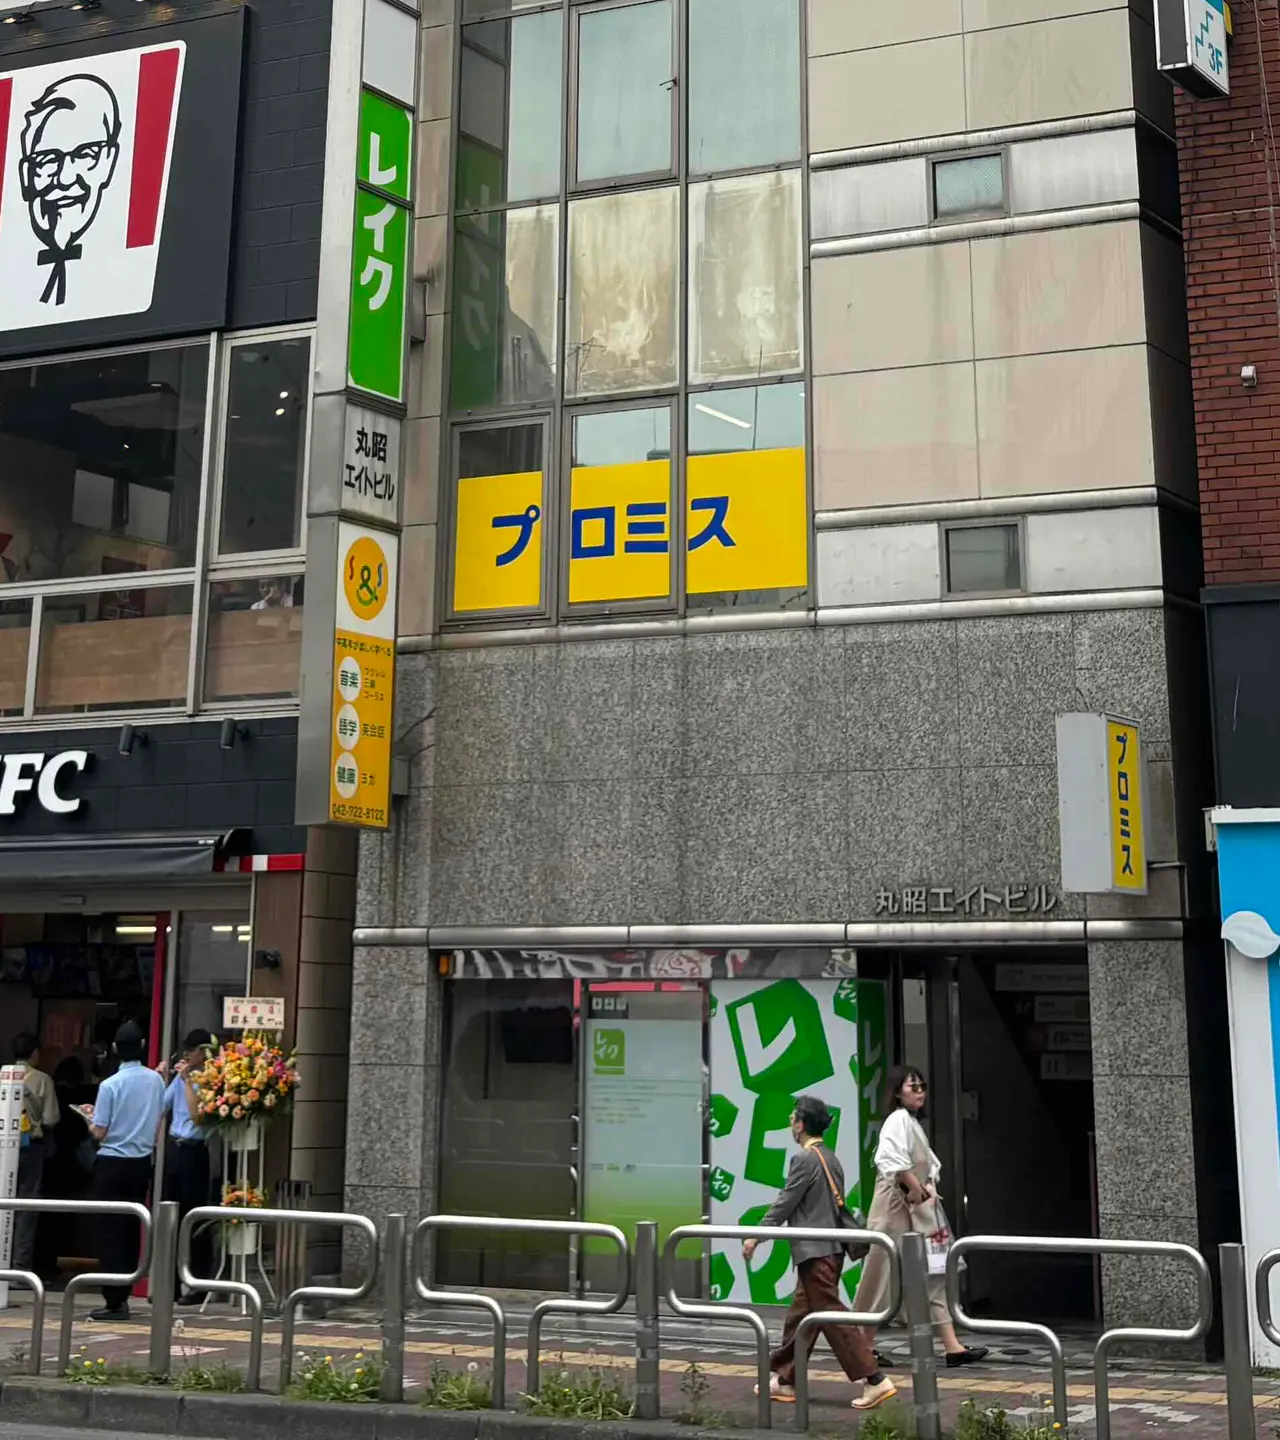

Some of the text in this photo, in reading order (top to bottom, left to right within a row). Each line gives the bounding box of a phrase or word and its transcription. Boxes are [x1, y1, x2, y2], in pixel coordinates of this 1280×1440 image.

[1208, 44, 1224, 76] 3F
[360, 131, 397, 310] レイク
[355, 428, 387, 463] 丸昭
[344, 465, 395, 501] エイトビル
[491, 496, 736, 566] プロミス
[1116, 732, 1133, 876] プロミス
[874, 884, 1060, 914] 丸昭エイトビル
